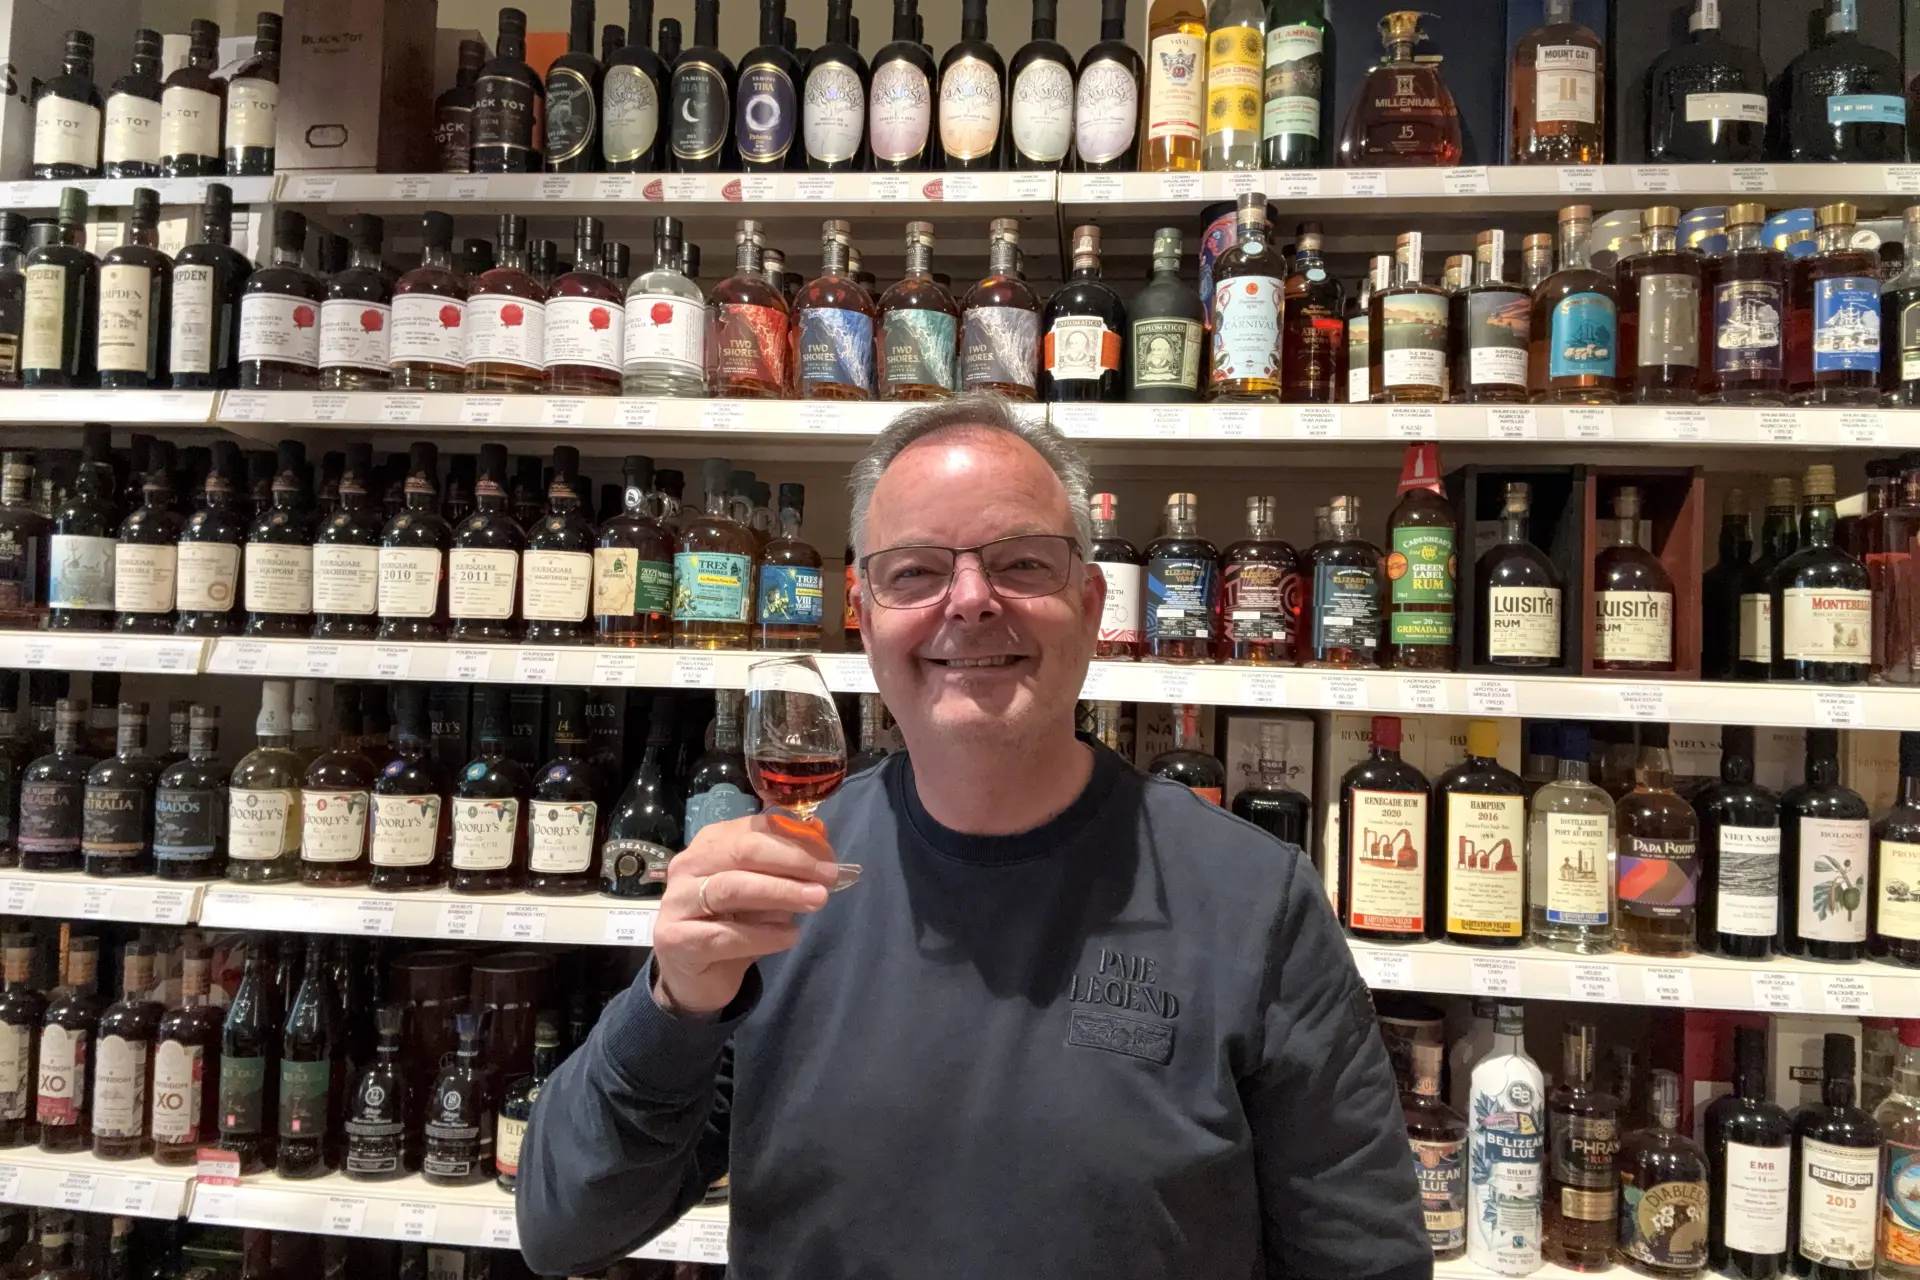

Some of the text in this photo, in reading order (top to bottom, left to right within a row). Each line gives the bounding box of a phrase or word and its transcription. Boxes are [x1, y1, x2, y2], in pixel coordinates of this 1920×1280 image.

[1544, 49, 1590, 60] MOUNT GAY
[252, 101, 276, 110] TOT
[502, 99, 526, 110] TOT
[1376, 98, 1436, 108] MILLENIUM
[177, 109, 200, 118] TOT
[57, 118, 80, 128] TOT
[127, 117, 150, 128] TOT
[1224, 321, 1276, 331] CARNIVAL
[730, 340, 752, 348] TWO
[808, 344, 828, 352] TWO
[968, 344, 987, 352] TWO
[722, 349, 758, 358] SHORES
[892, 346, 912, 354] TWO
[802, 353, 836, 362] SHORES
[886, 354, 921, 364] SHORES
[966, 353, 996, 362] SHORES
[1403, 536, 1452, 548] CADENHEAD'S
[698, 560, 728, 569] TRES
[1412, 564, 1444, 572] GREEN
[384, 570, 412, 580] 2010
[460, 572, 488, 581] 2011
[698, 568, 728, 576] HOMBRES
[796, 575, 818, 584] TRES
[1332, 576, 1374, 584] ELIZABETH
[1412, 579, 1444, 590] RUM
[796, 596, 812, 604] VIII
[1494, 594, 1553, 614] LUISITA
[1596, 600, 1658, 618] LUISITA
[1494, 620, 1520, 628] RUM
[1596, 624, 1622, 632] RUM
[1396, 626, 1437, 634] GRENADA
[558, 720, 569, 730] 14
[1364, 796, 1418, 808] RENEGADE RUM
[1470, 800, 1506, 810] HAMPDEN
[231, 808, 283, 821] DOORLY'S
[1382, 810, 1402, 818] 2020
[1478, 812, 1498, 822] 2016
[376, 816, 422, 828] DOORLY'S
[1560, 818, 1598, 826] DISTILLERIE
[456, 822, 499, 834] DOORLY'S
[535, 824, 580, 837] DOORLY'S
[1554, 829, 1571, 837] PORT
[1583, 830, 1604, 838] PRINCE
[1724, 832, 1752, 842] VIEUX
[1820, 831, 1864, 840] BOLOGNE
[620, 842, 665, 858] SEALE'S
[1632, 839, 1662, 854] PAPA
[1069, 974, 1180, 1019] LEGEND
[40, 1075, 66, 1092] XO
[369, 1091, 379, 1100] 12
[156, 1092, 183, 1110] XO
[1487, 1130, 1544, 1147] BELIZEAN
[1502, 1147, 1535, 1158] BLUE
[1750, 1161, 1775, 1171] EMB
[1416, 1168, 1460, 1180] LIZEAN
[1506, 1168, 1532, 1176] SILVER
[1826, 1194, 1857, 1208] 2013
[1426, 1214, 1442, 1223] UM
